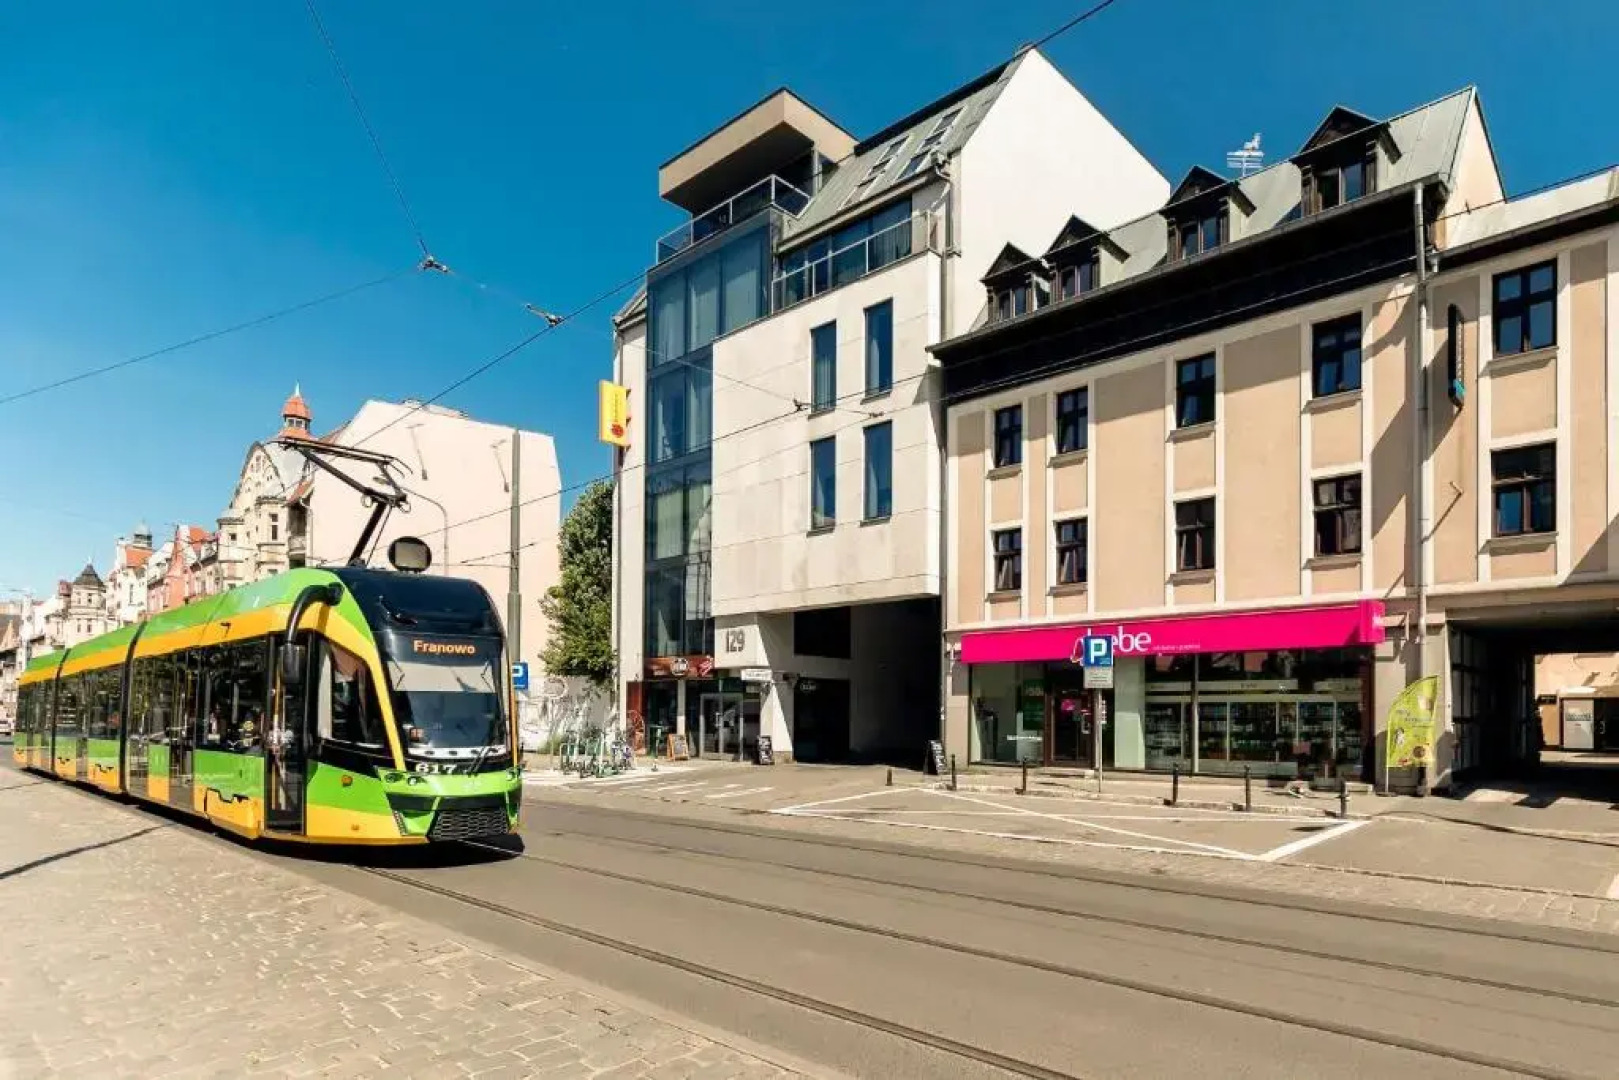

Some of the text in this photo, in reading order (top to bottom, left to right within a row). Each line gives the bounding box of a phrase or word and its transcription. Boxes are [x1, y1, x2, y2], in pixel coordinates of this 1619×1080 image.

[413, 639, 476, 654] Franowo
[726, 629, 745, 652] 129
[1090, 638, 1107, 664] P
[415, 763, 457, 774] 617
